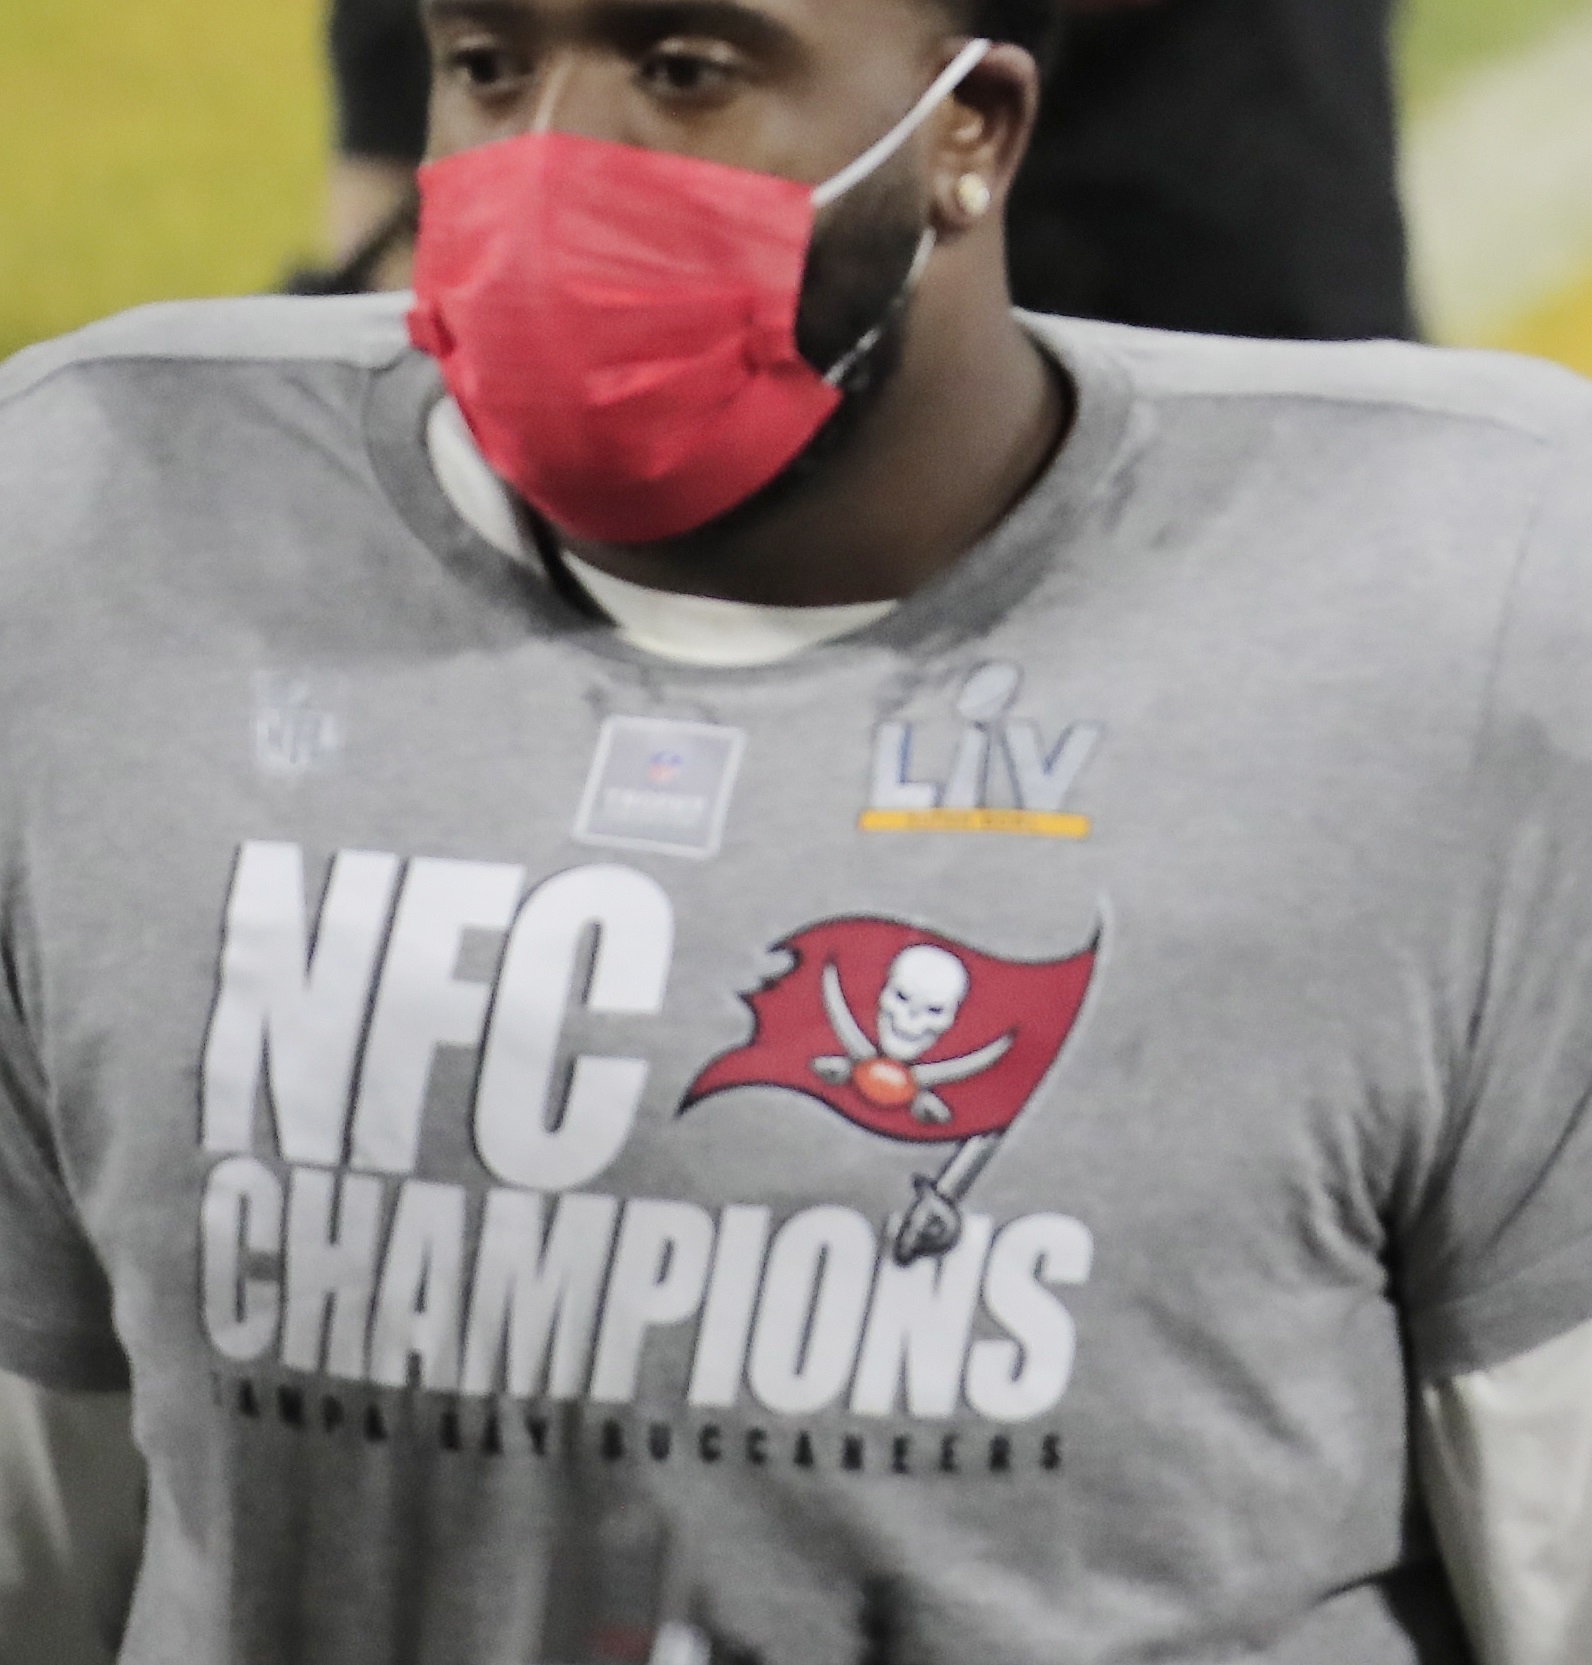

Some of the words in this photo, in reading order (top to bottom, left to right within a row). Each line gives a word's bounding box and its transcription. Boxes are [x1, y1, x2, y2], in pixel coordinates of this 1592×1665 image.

[867, 681, 1103, 811] LIV
[200, 839, 675, 1189] NFC
[200, 1155, 1095, 1423] CHAMPIONS
